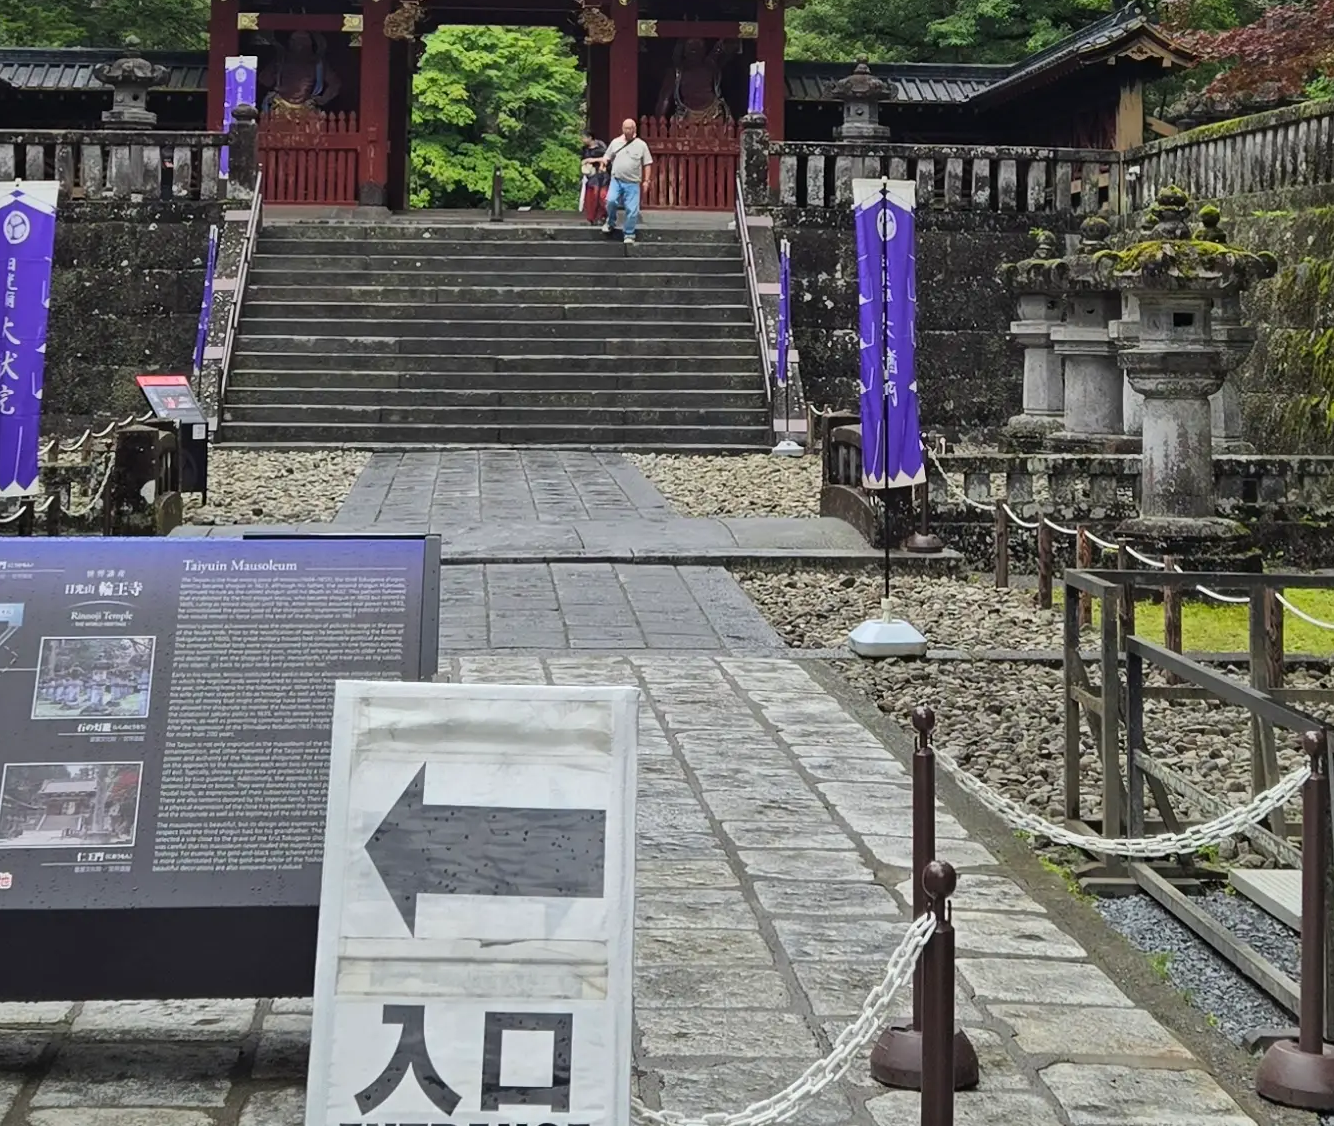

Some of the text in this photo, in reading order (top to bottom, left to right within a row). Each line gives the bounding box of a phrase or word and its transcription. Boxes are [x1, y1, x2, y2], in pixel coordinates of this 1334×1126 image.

[183, 559, 297, 572] Taiyuin Mausoleum
[65, 581, 144, 597] 日光山 輪王寺
[71, 610, 134, 623] Rinnoji Temple
[354, 1004, 573, 1116] 入口
